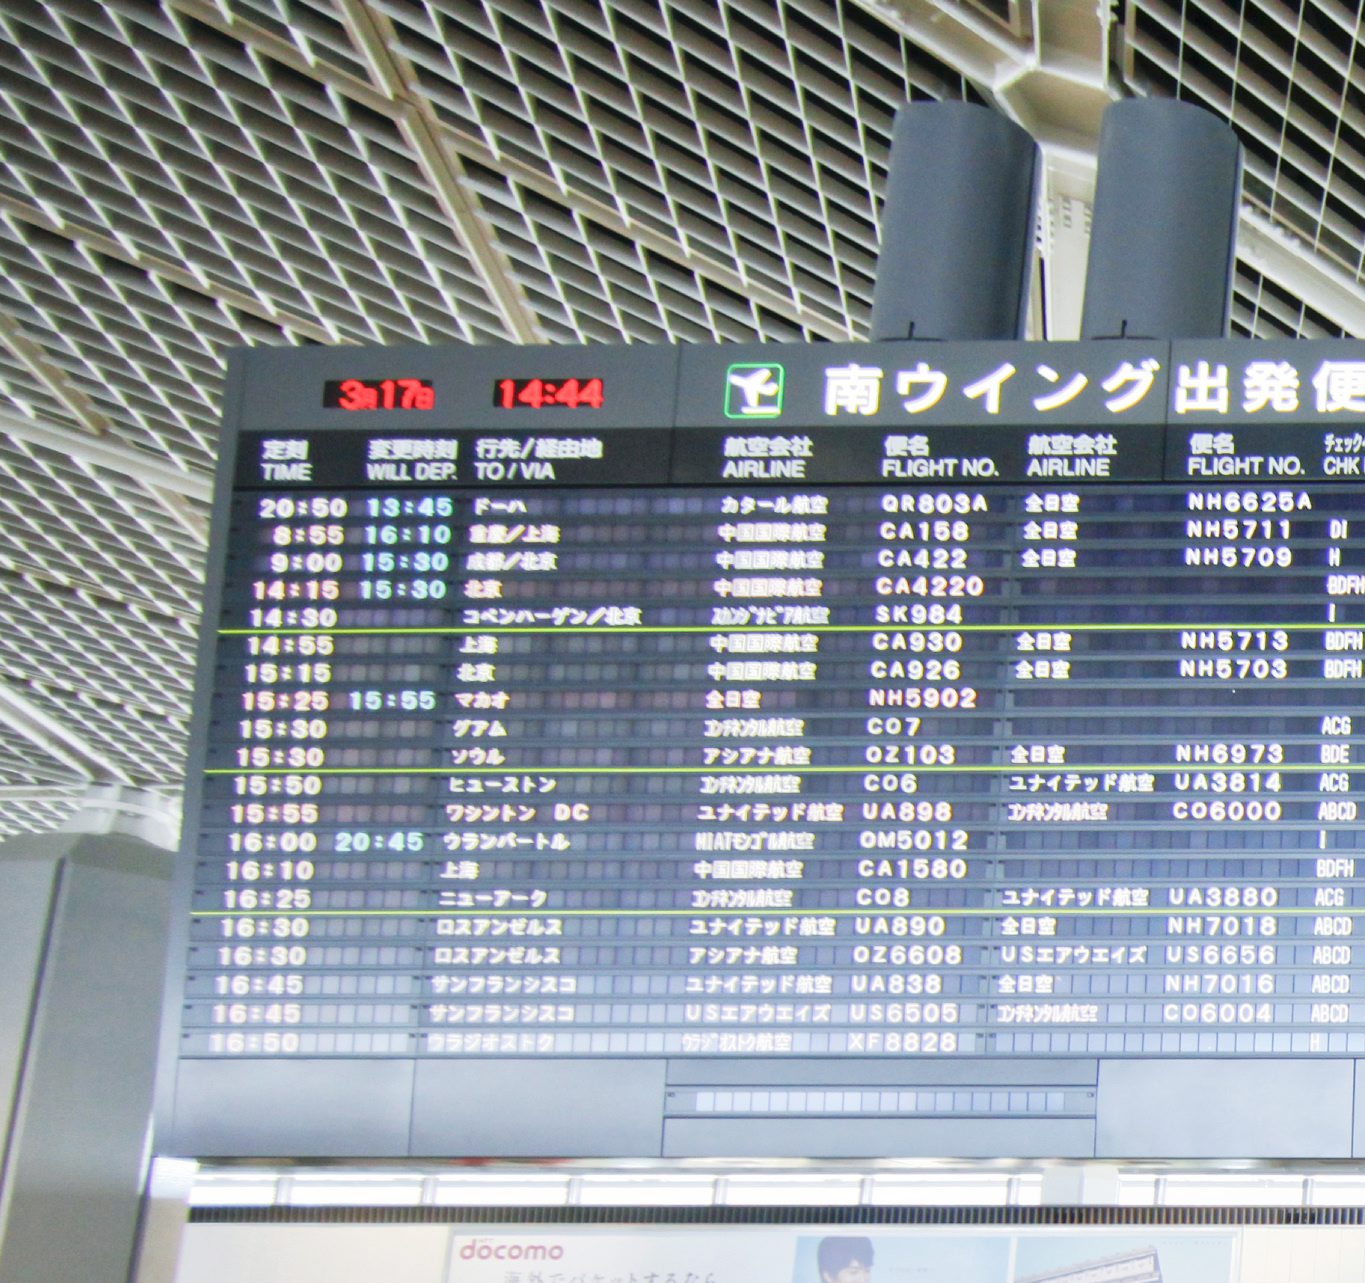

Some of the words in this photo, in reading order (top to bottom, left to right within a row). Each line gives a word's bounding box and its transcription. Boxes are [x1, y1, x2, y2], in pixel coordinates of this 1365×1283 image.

[500, 378, 604, 409] 14:44
[262, 440, 308, 460] 定刻
[723, 436, 813, 457] 航空会社
[884, 435, 930, 456] 便名
[1027, 434, 1118, 455] 航空会社
[1190, 433, 1235, 454] 便名
[261, 463, 312, 481] TIME
[367, 463, 412, 481] WILL
[415, 463, 458, 481] DEP.
[475, 463, 504, 480] TO
[516, 463, 555, 480] VIA
[722, 460, 806, 478] AIRLINE
[882, 459, 957, 477] FLIGHT
[960, 458, 1000, 477] NO.
[1027, 459, 1110, 477] AIRLINE
[1187, 456, 1264, 475] FLIGHT
[1268, 457, 1306, 475] NO.
[1324, 457, 1360, 475] CHK
[259, 499, 348, 518] 20:50
[367, 499, 453, 517] 13:45
[475, 500, 527, 515] ドーハ
[882, 494, 988, 514] QR803A
[1025, 493, 1080, 512] 全日空
[1187, 492, 1312, 512] NH6625A
[270, 553, 343, 572] 9:00
[363, 553, 449, 572] 15:30
[878, 550, 968, 568] CA422
[1185, 547, 1293, 566] NH5709
[250, 608, 338, 628] 14:30
[875, 605, 963, 624] SK984
[247, 637, 335, 656] 14:55
[872, 633, 963, 652] CA930
[1181, 632, 1289, 650] NH5713
[242, 691, 330, 710] 15:25
[350, 691, 436, 710] 15:55
[455, 692, 511, 710] マカオ
[705, 689, 762, 708] 全日空
[868, 689, 977, 708] NH5902
[236, 748, 325, 767] 15:30
[452, 749, 506, 766] ソウル
[865, 746, 956, 764] OZ103
[1176, 744, 1284, 763] NH6973
[231, 804, 319, 823] 15:55
[553, 804, 590, 821] DC
[862, 803, 953, 821] UA898
[460, 1238, 564, 1260] docomo
